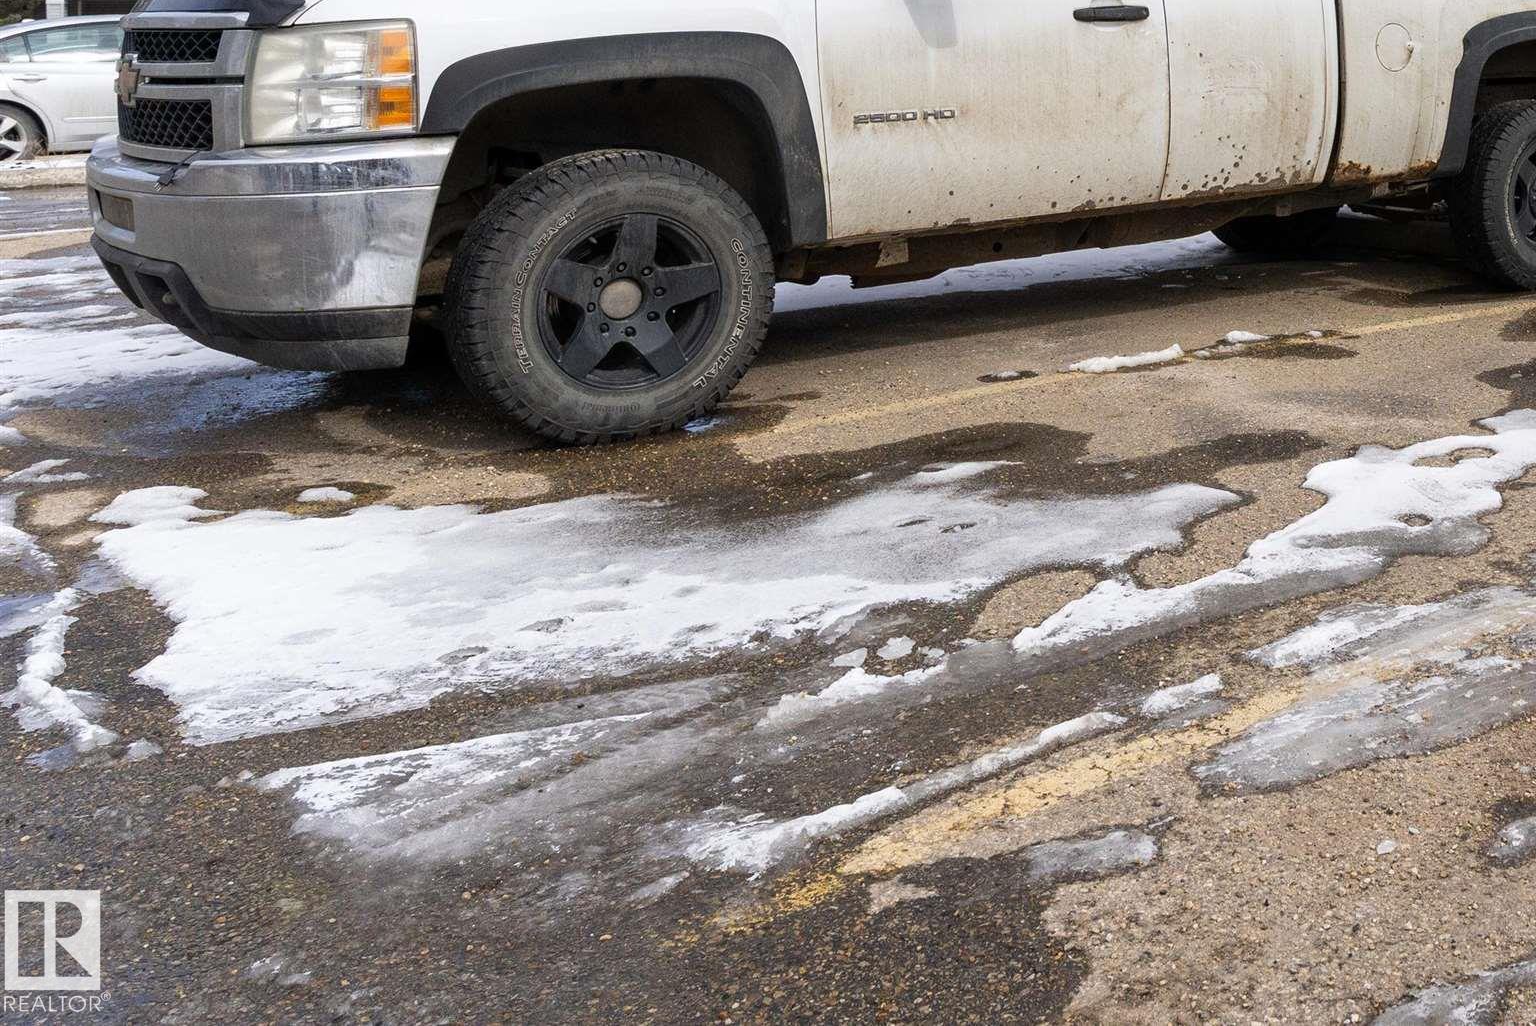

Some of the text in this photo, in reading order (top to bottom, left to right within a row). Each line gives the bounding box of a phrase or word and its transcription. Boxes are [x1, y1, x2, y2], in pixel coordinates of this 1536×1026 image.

[853, 109, 956, 125] 2500 HD
[692, 237, 753, 393] CONTINENTAL
